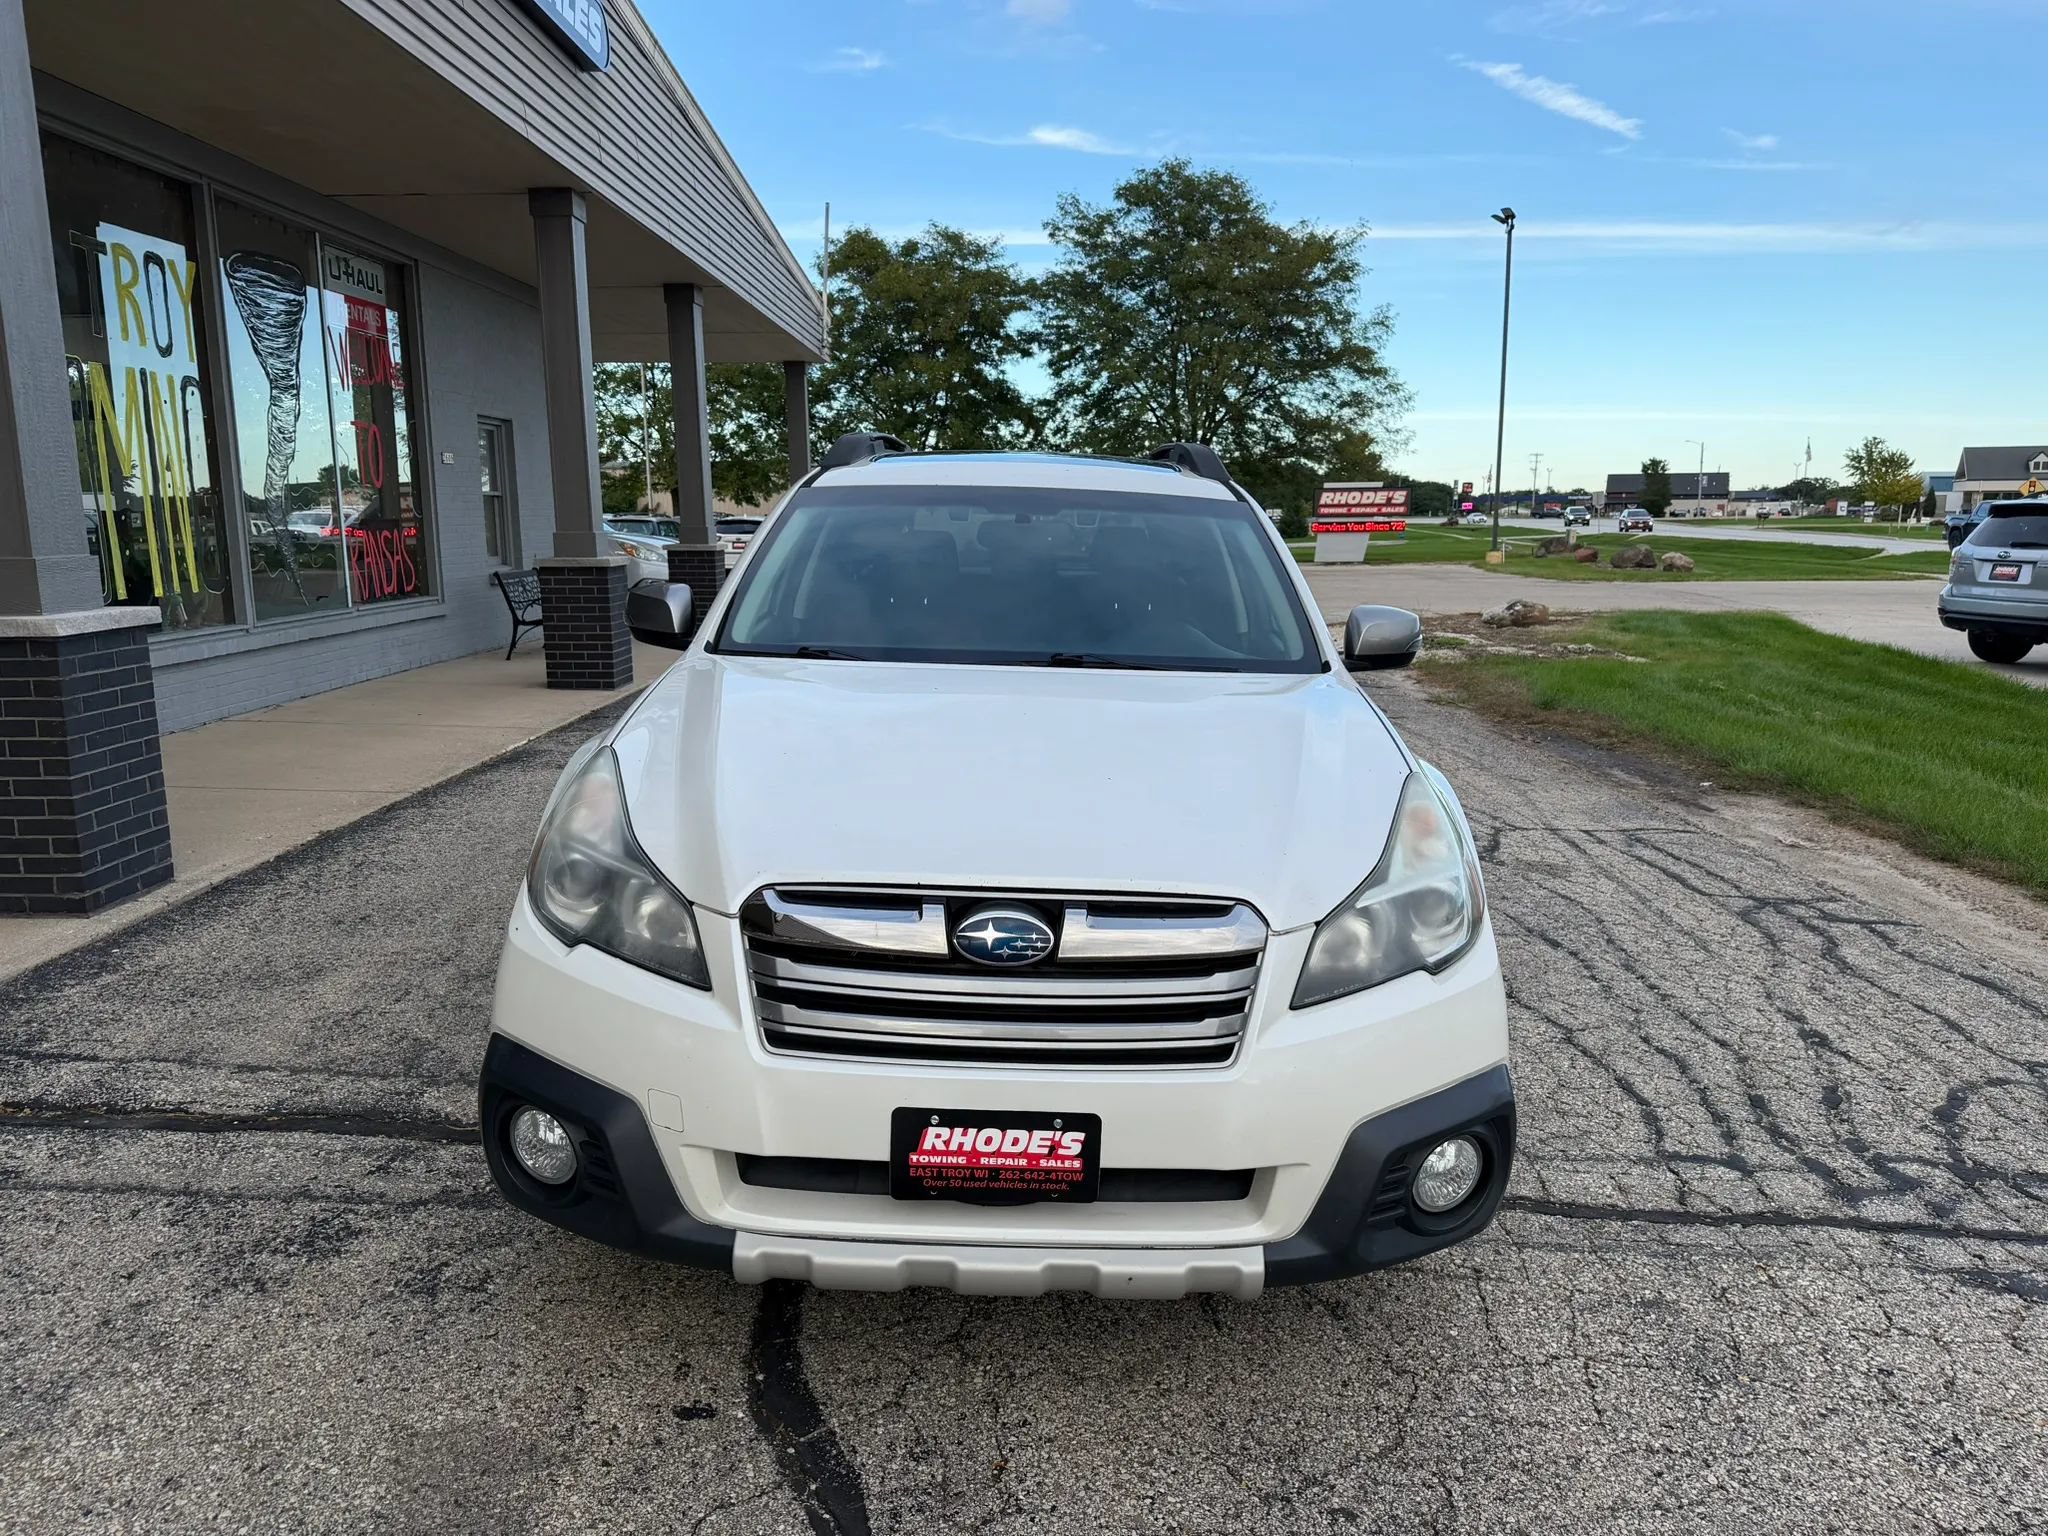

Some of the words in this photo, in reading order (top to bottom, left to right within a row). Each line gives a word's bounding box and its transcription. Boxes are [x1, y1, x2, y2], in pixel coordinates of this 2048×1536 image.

[69, 229, 197, 363] TROY
[350, 420, 384, 489] TO
[1319, 490, 1408, 505] RHODE'S
[1320, 506, 1348, 514] TOWING
[1347, 522, 1365, 531] You
[1365, 522, 1390, 531] Since
[351, 527, 416, 601] KANSAS
[920, 1126, 1086, 1156] RHODE'S
[910, 1154, 968, 1164] TOWING
[980, 1156, 1028, 1166] REPAIR
[1039, 1158, 1081, 1168] SALES
[909, 1167, 939, 1177] EAST
[941, 1168, 972, 1178] TROY
[974, 1169, 989, 1178] WI
[998, 1170, 1084, 1182] 262-642-4TOW
[923, 1178, 948, 1187] Over
[949, 1179, 962, 1188] 50
[963, 1179, 988, 1188] used
[989, 1179, 1028, 1189] vehicles
[1029, 1180, 1039, 1189] in
[1041, 1181, 1070, 1191] stock.
